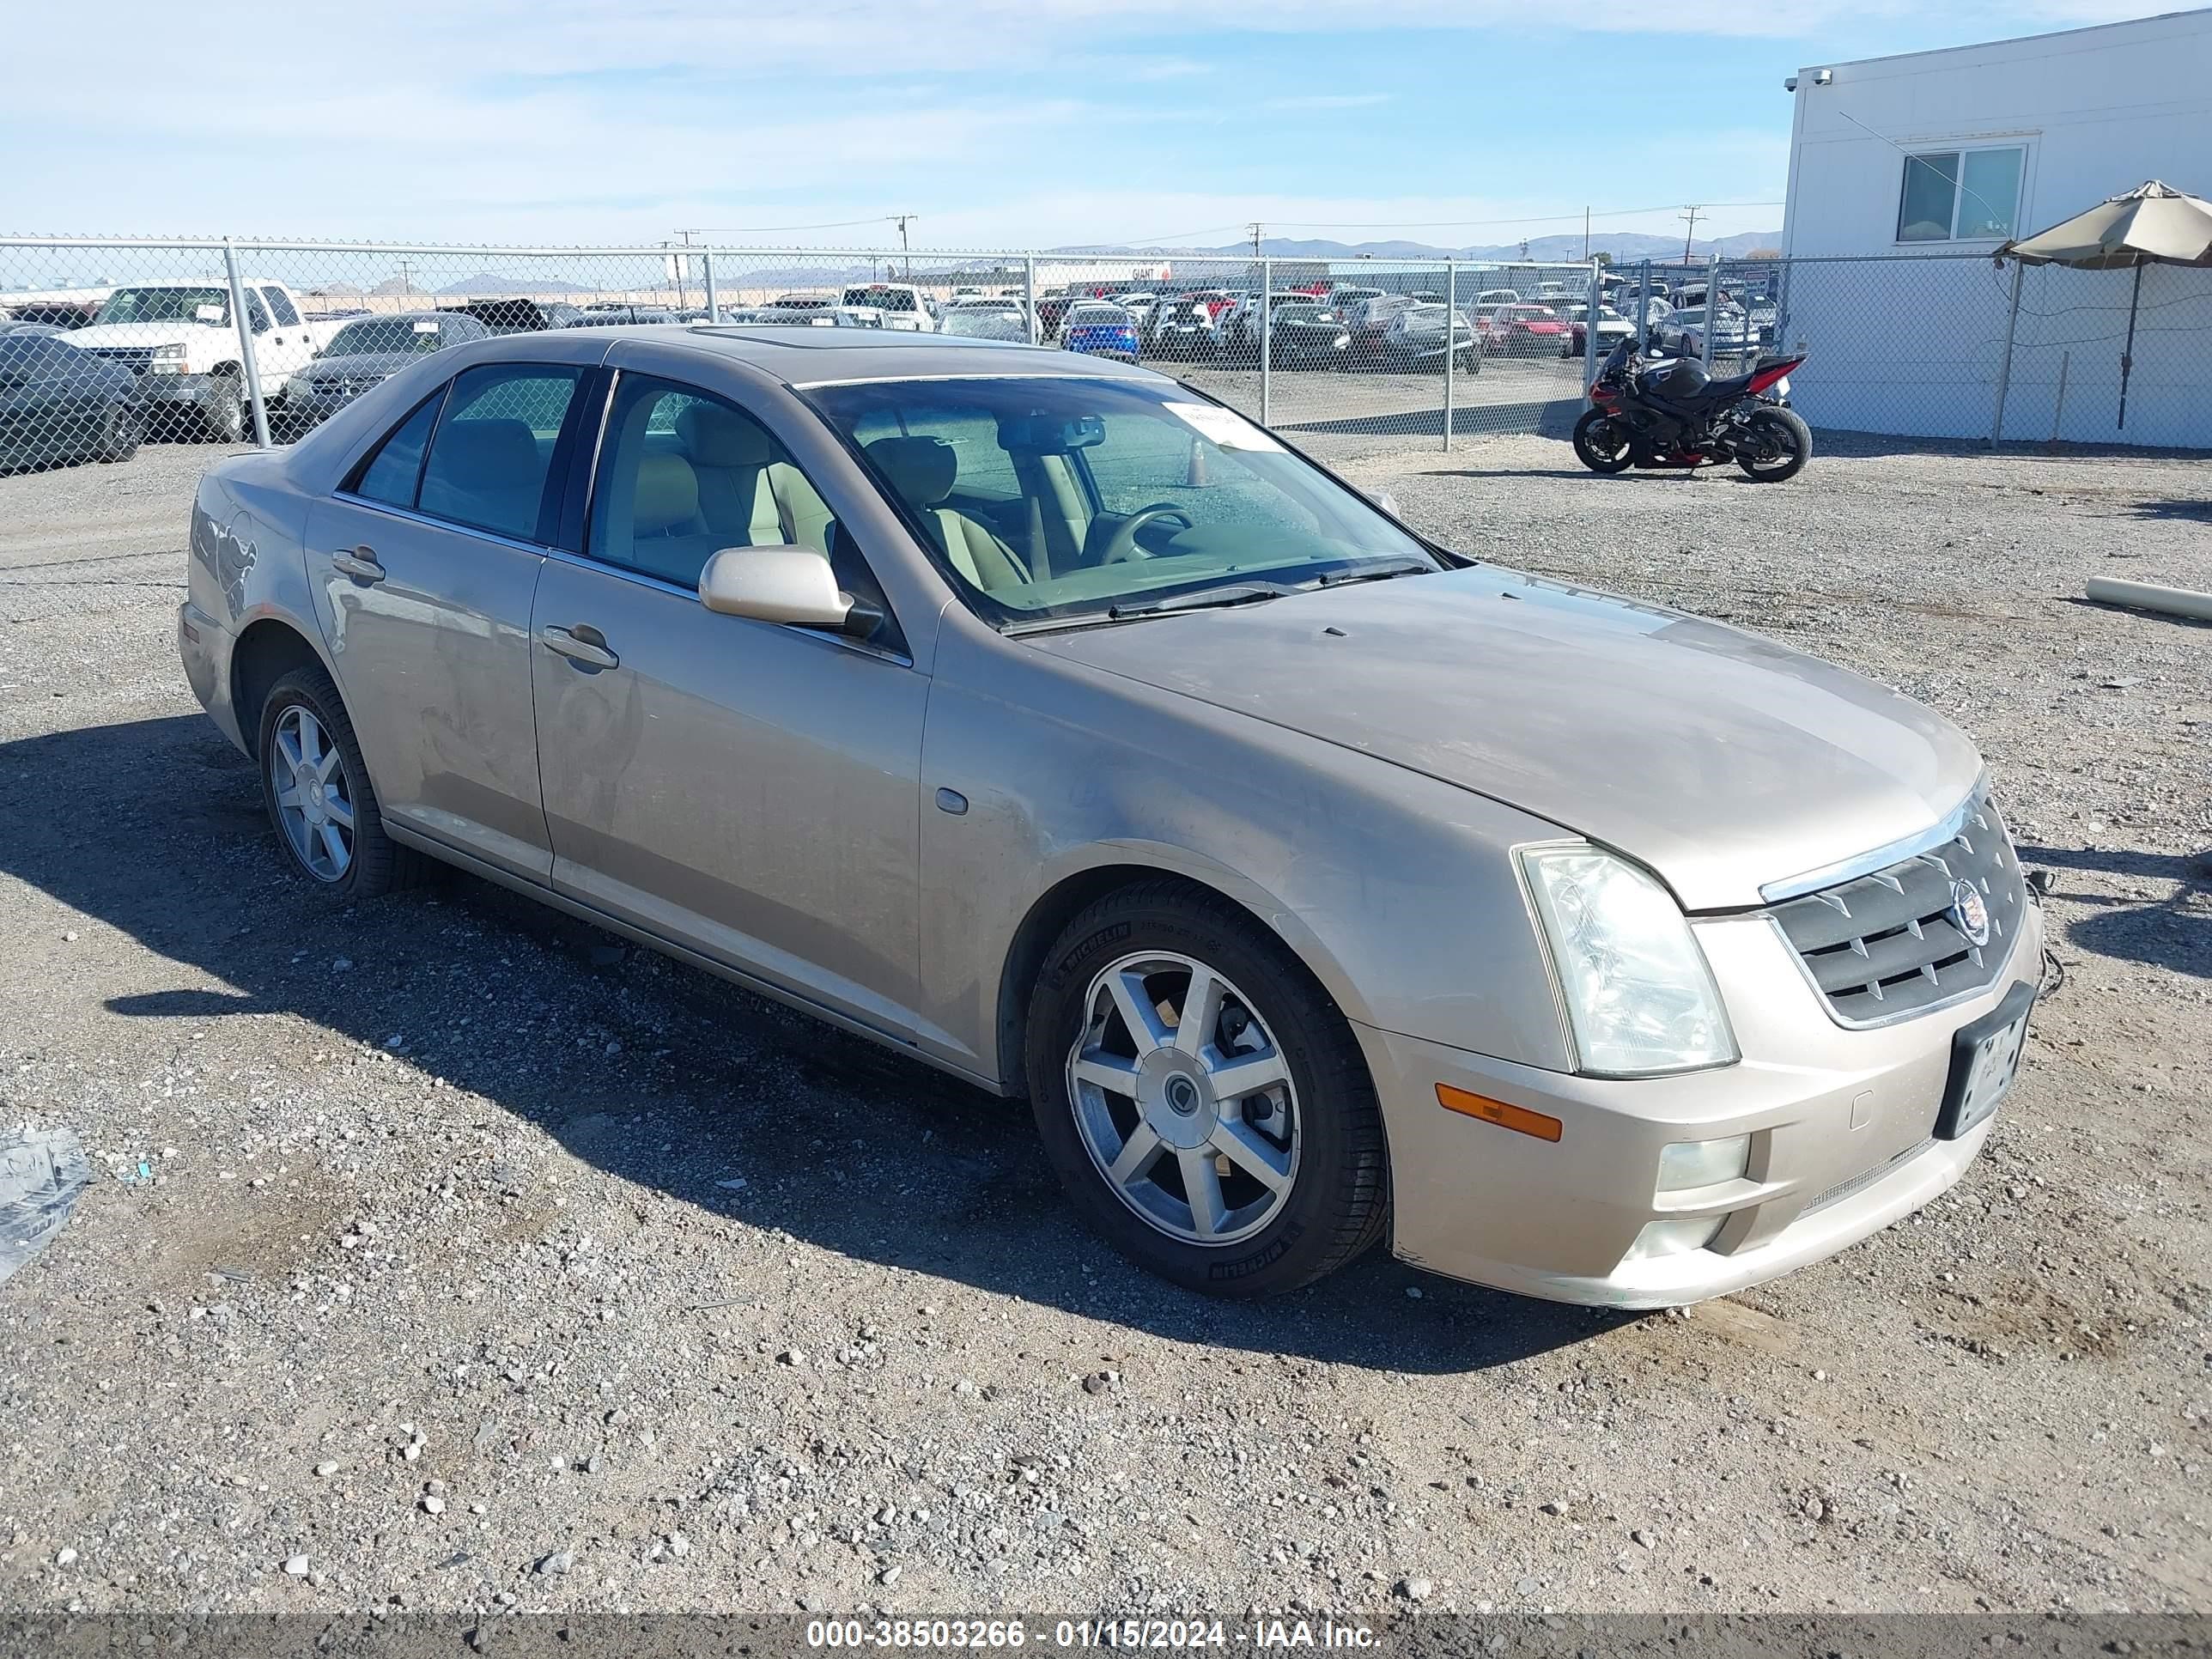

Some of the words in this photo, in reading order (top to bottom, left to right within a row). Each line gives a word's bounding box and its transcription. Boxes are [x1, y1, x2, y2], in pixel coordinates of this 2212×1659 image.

[1133, 268, 1154, 281] GIANT
[1066, 923, 1128, 969] MICHELIN
[1212, 1240, 1285, 1279] MICHELIN
